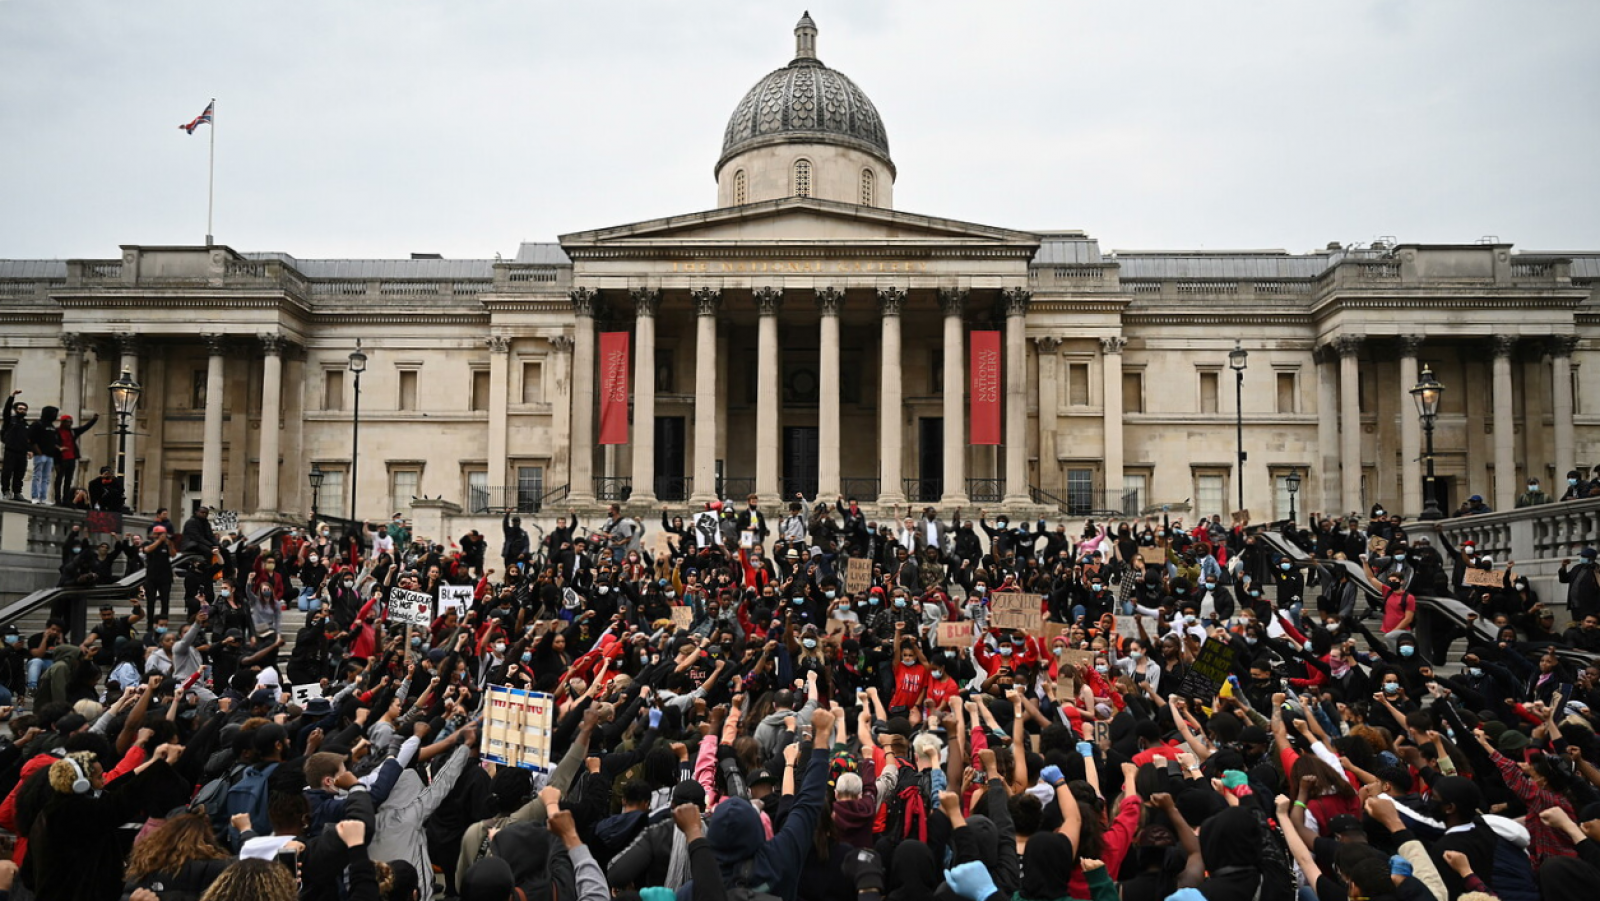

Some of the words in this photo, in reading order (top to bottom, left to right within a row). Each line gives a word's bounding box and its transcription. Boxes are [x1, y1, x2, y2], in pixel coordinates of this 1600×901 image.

[672, 262, 707, 272] THE
[722, 262, 822, 272] NATIONAL
[837, 262, 928, 272] GALLERY
[608, 351, 616, 402] NATIONAL
[616, 350, 625, 402] GALLERY
[978, 351, 987, 402] NATIONAL
[987, 349, 997, 403] GALLERY
[850, 561, 871, 570] BLACK
[946, 624, 970, 639] BLM
